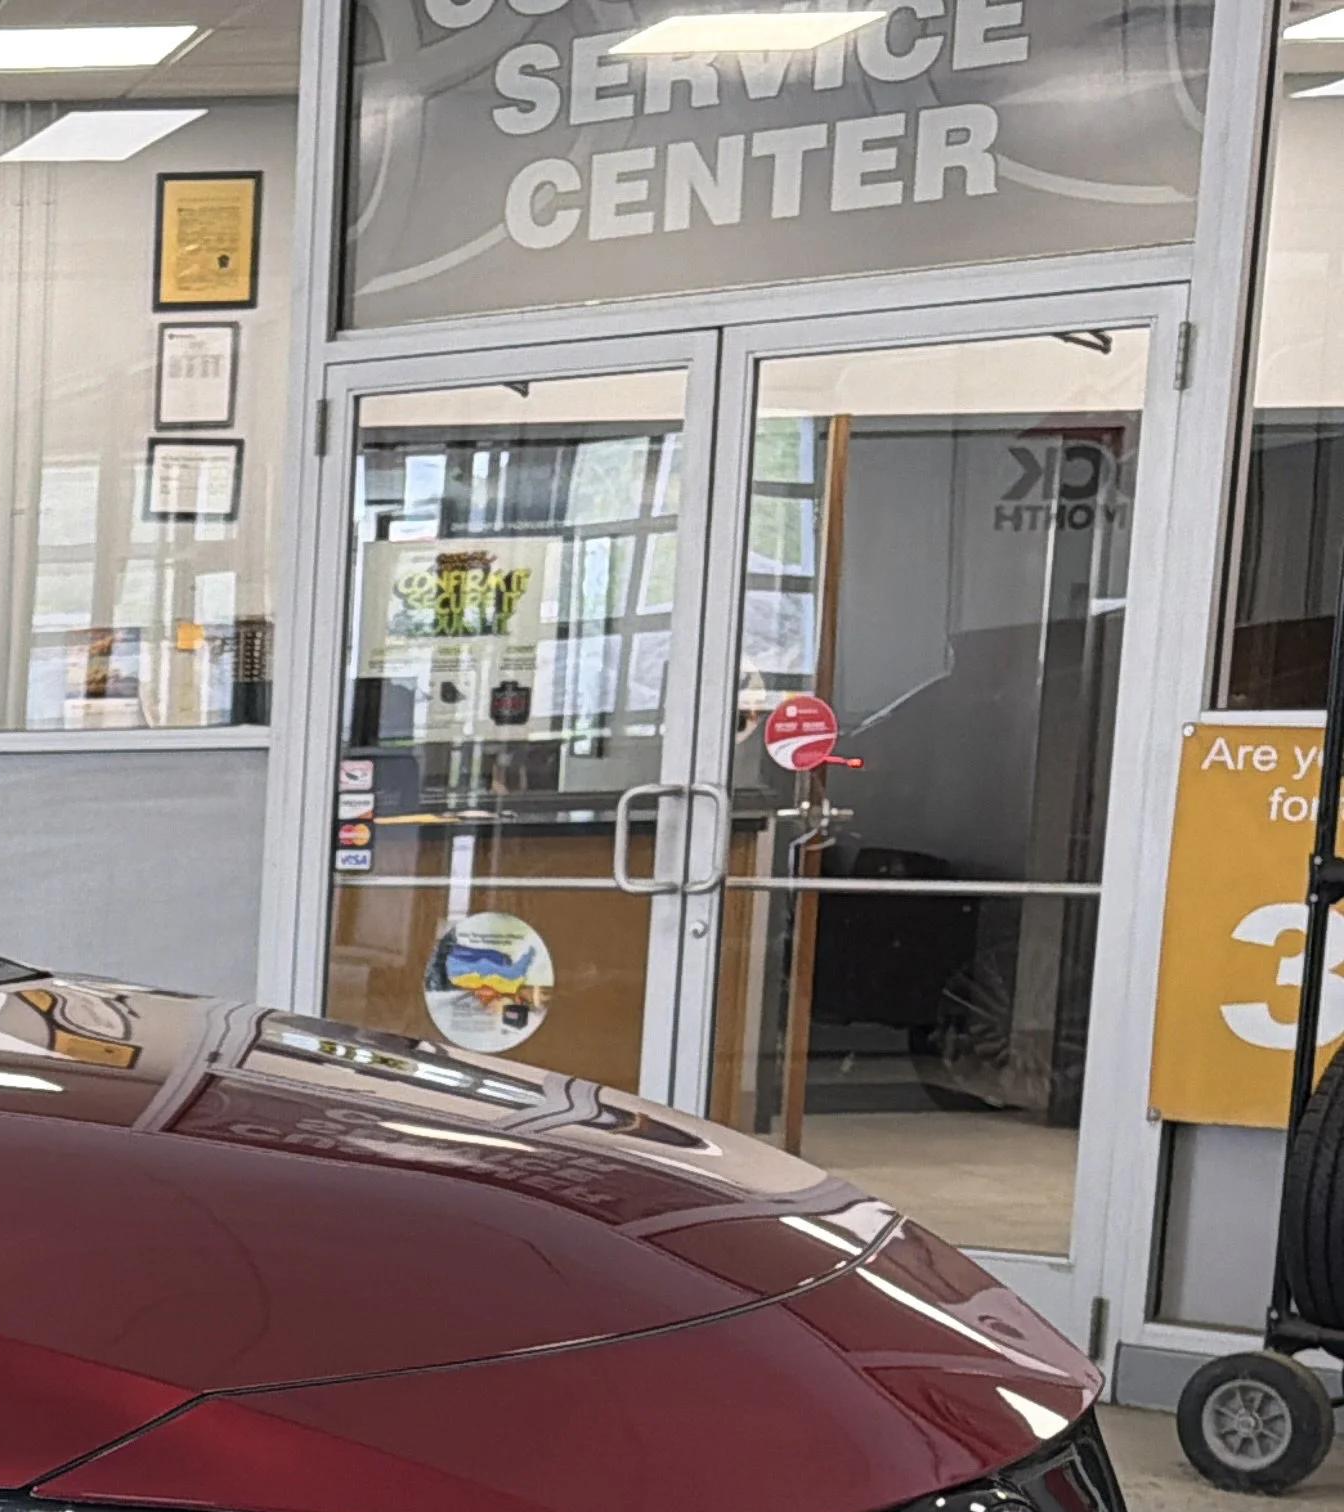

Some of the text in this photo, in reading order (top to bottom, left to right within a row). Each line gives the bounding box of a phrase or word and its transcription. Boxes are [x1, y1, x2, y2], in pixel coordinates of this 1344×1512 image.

[492, 0, 1028, 135] SERVICE
[505, 103, 998, 249] CENTER
[1200, 736, 1324, 780] Are y
[341, 854, 369, 867] VISA
[1219, 903, 1344, 1051] 3
